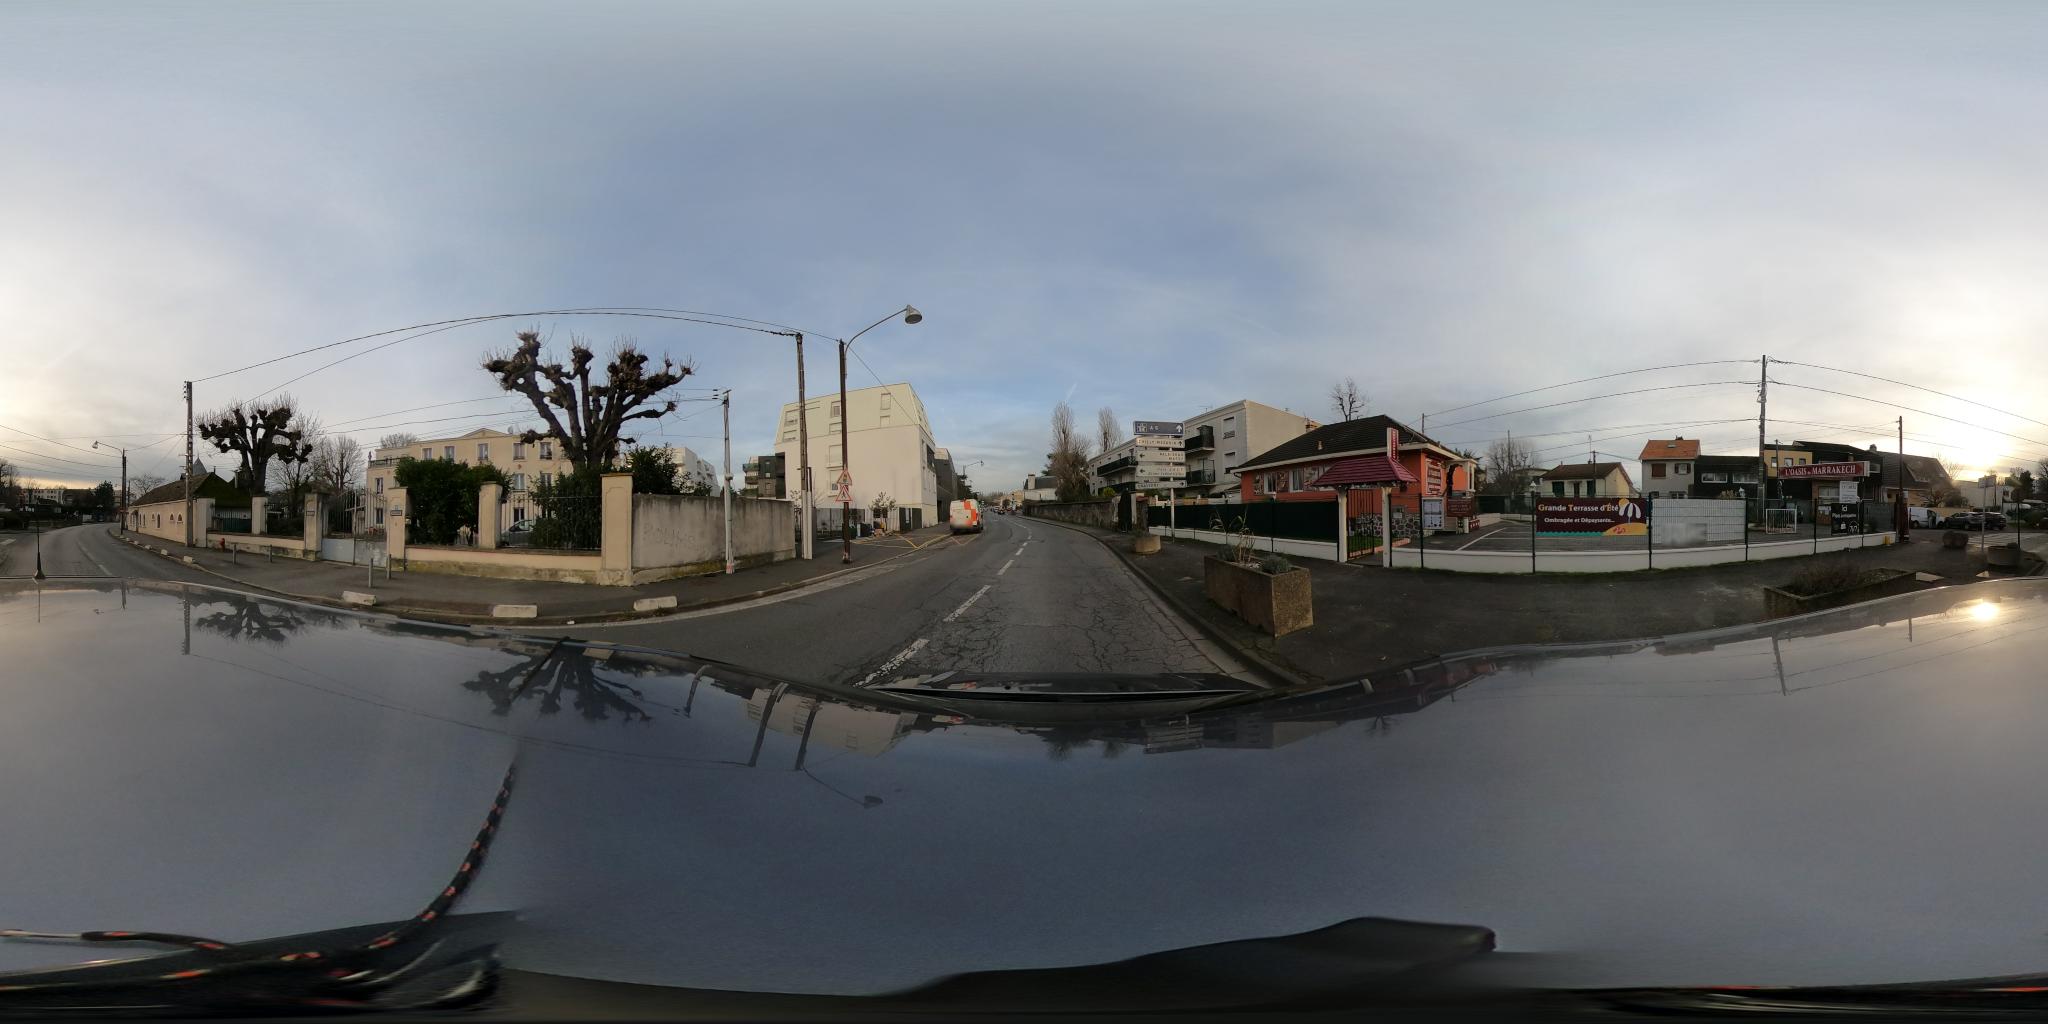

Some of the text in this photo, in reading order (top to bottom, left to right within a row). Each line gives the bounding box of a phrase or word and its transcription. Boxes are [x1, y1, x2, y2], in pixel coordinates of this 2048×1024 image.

[1812, 465, 1856, 475] MARRAKECH
[1538, 504, 1566, 512] Grande
[1568, 504, 1599, 512] Terrasse
